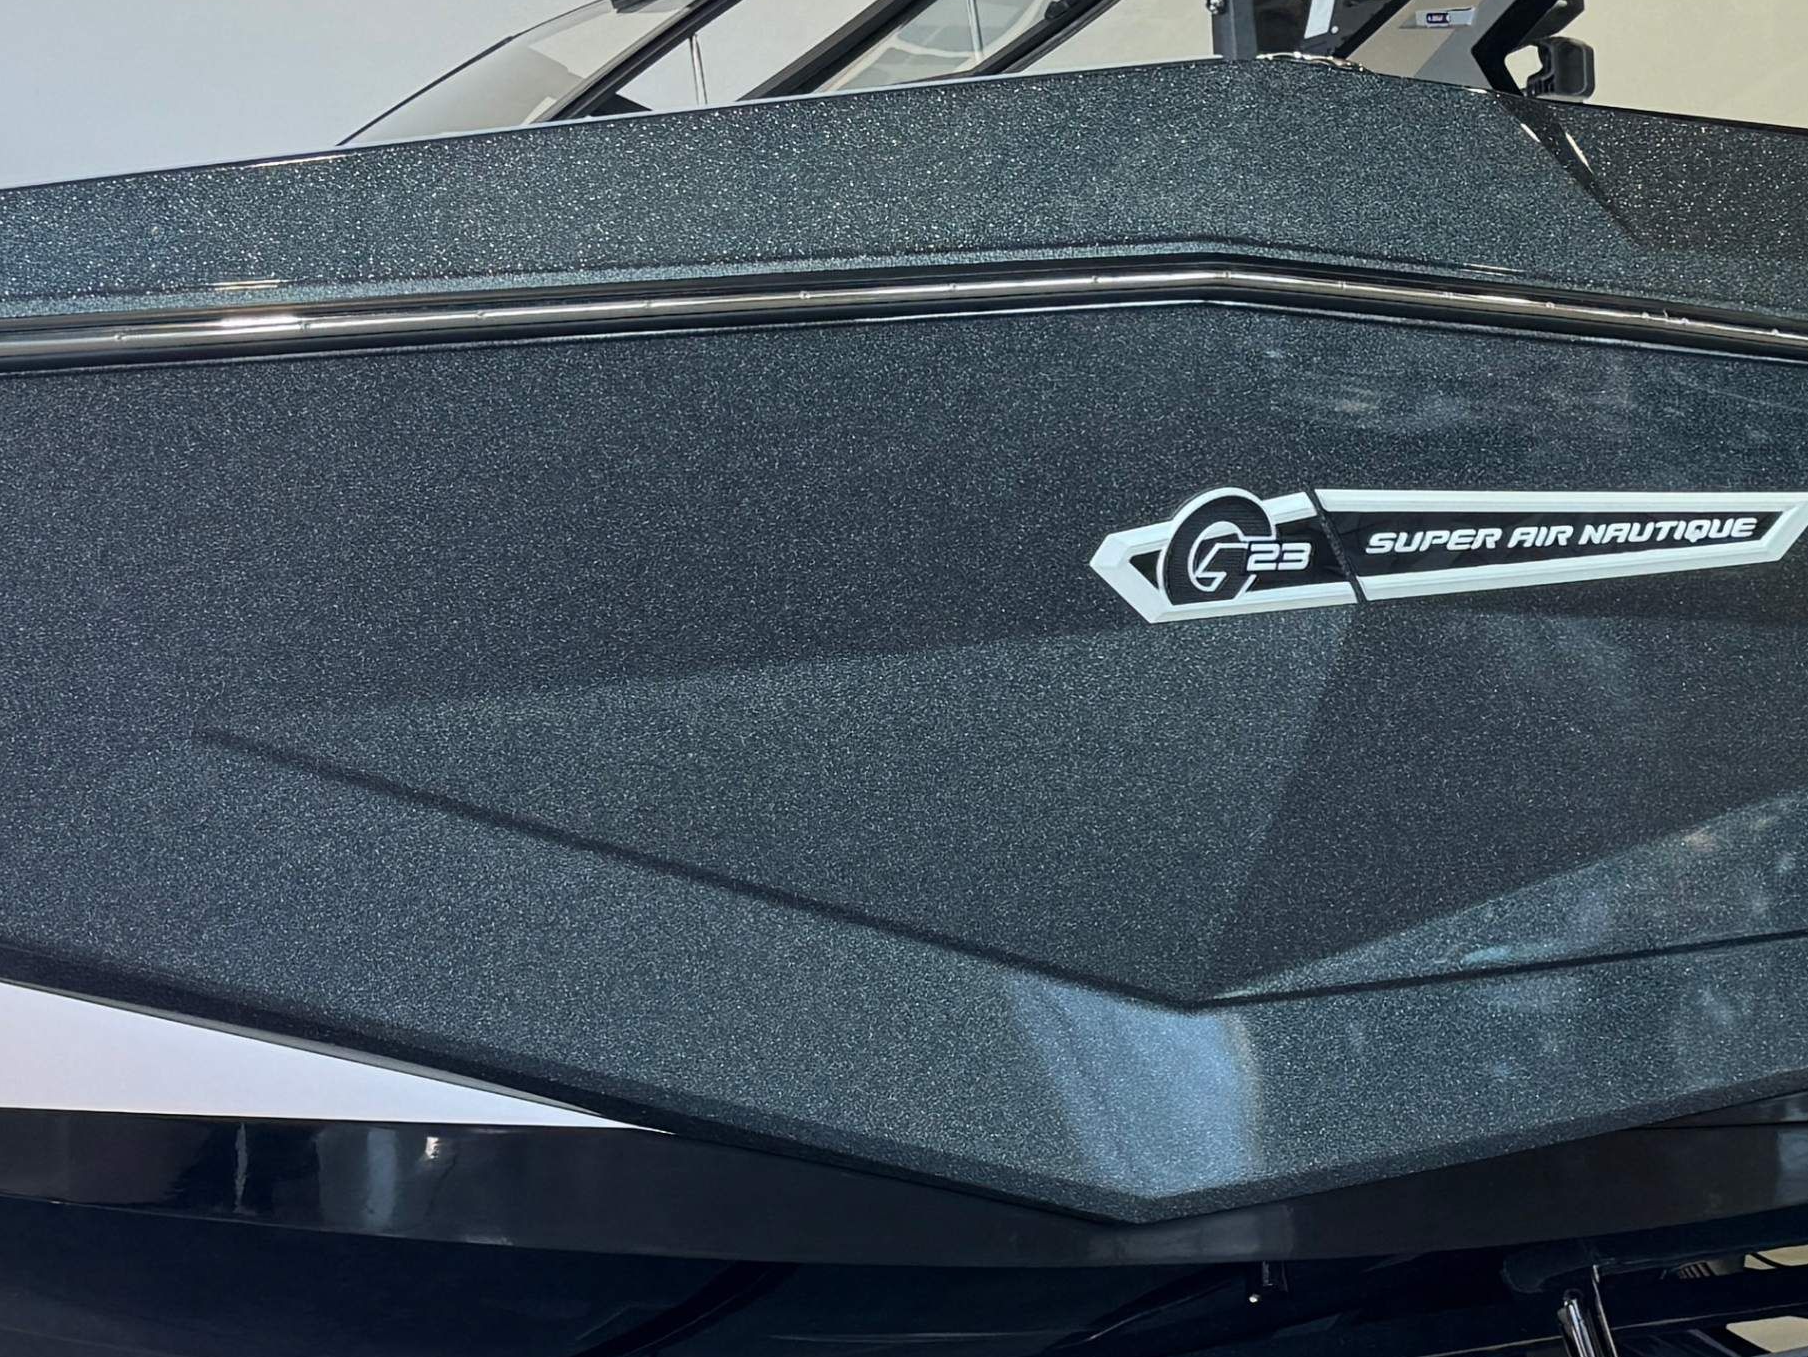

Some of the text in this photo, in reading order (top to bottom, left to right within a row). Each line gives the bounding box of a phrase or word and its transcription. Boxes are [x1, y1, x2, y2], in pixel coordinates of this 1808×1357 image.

[1364, 528, 1499, 555] SUPER
[1504, 524, 1571, 548] AIR
[1581, 517, 1758, 545] NAUTIQUE
